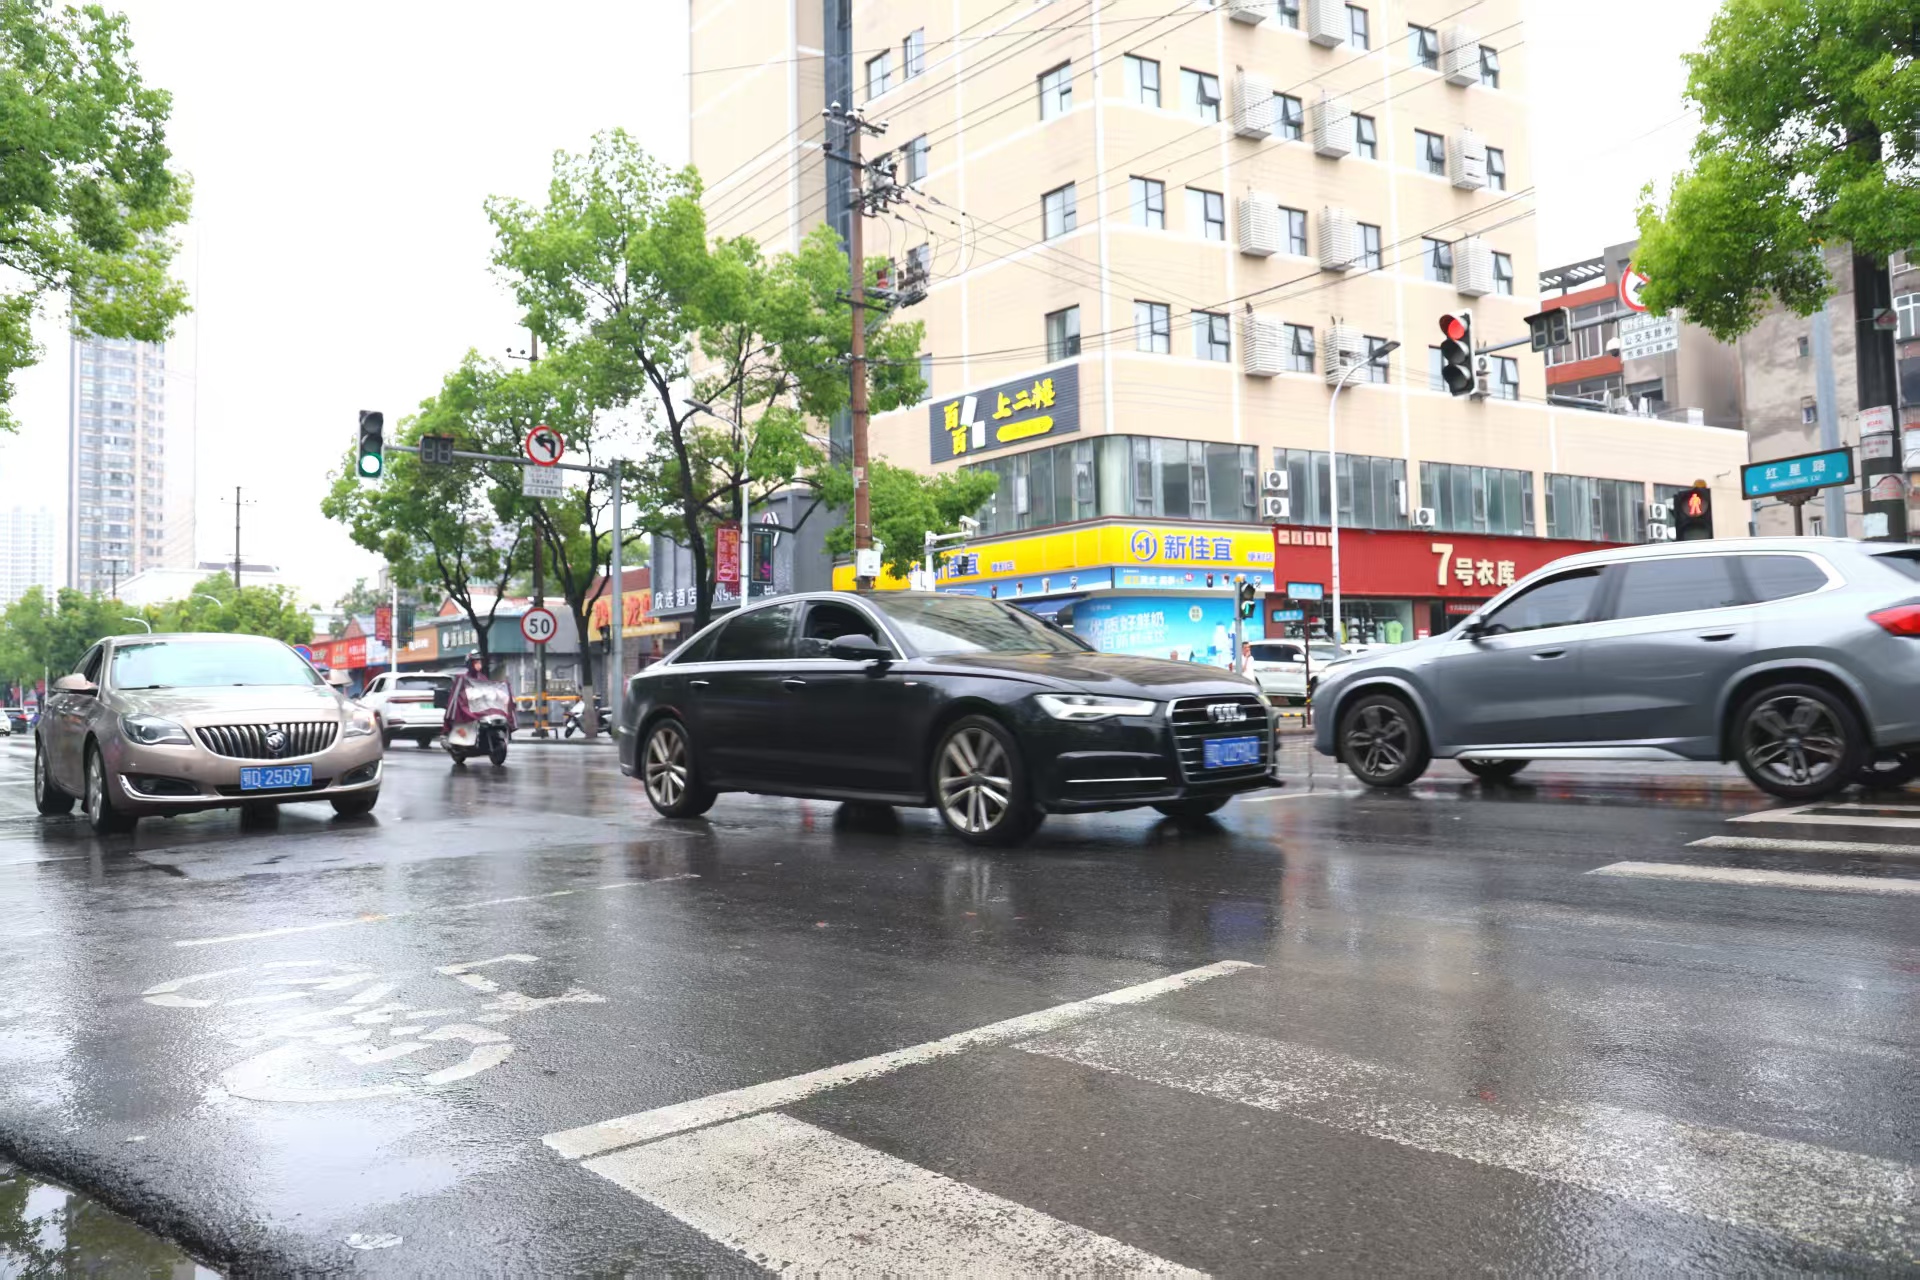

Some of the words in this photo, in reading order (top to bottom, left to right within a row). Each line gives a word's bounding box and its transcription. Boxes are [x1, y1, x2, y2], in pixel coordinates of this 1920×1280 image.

[1625, 326, 1673, 345] 公交车除外
[992, 378, 1056, 420] 上二楼
[1765, 460, 1826, 480] 红星路
[1164, 535, 1233, 561] 新佳宜
[991, 561, 1015, 573] 便利店
[1432, 543, 1517, 587] 7号衣库
[655, 586, 697, 610] 欣选酒店
[529, 619, 550, 634] 50
[1090, 612, 1165, 637] 优质好鲜奶
